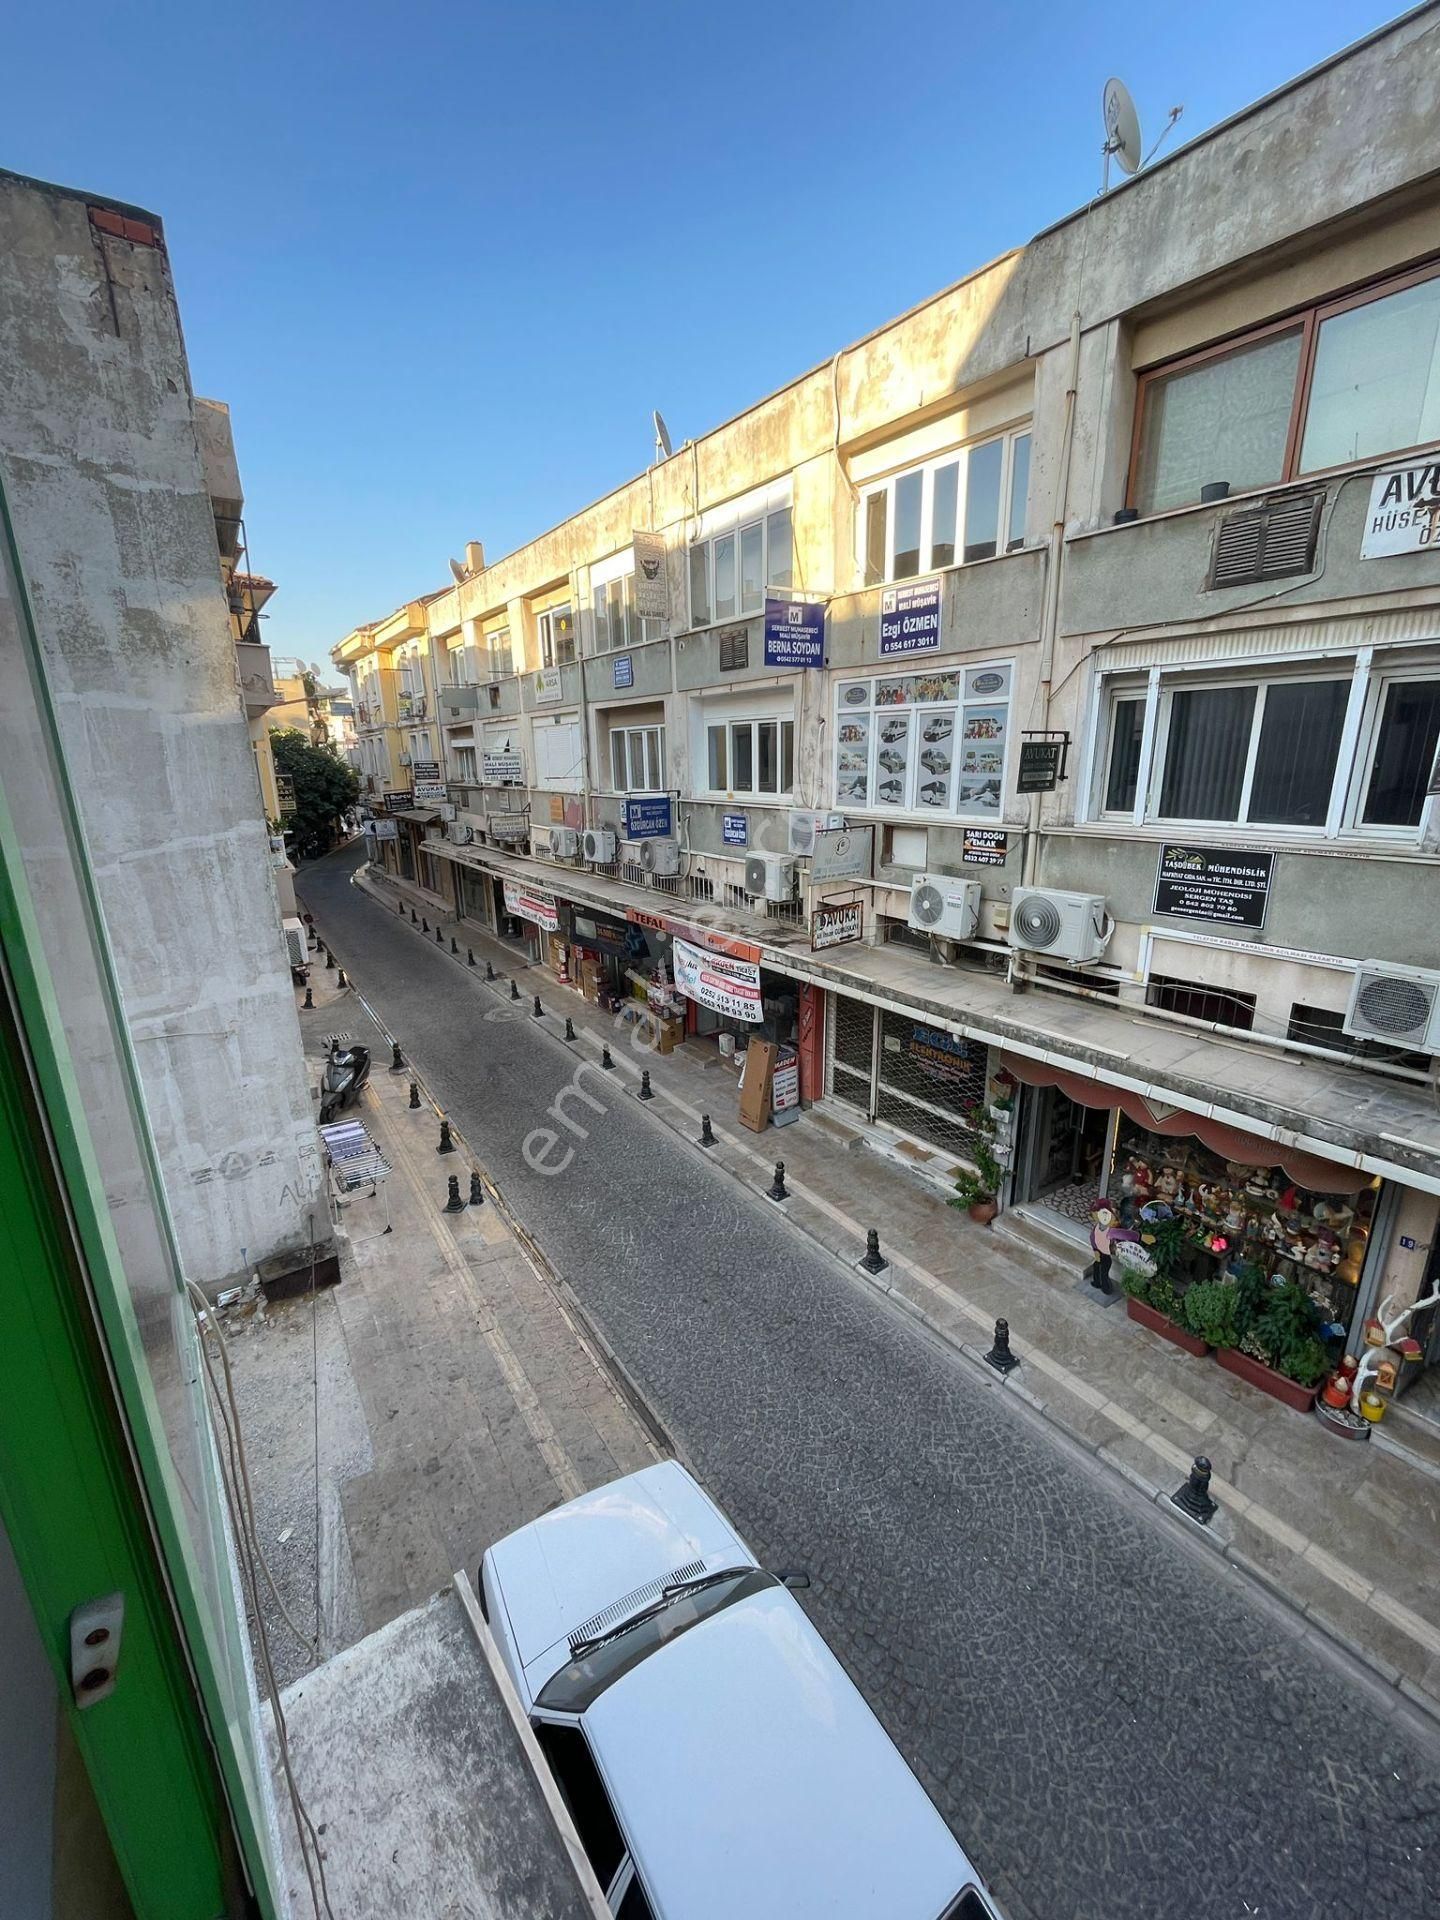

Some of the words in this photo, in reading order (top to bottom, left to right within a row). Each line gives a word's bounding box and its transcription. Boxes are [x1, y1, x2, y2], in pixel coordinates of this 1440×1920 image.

[882, 620, 901, 639] Ezgi
[902, 613, 938, 634] ÖZMEN
[768, 640, 791, 654] BERNA
[792, 641, 820, 655] SOYDAN
[884, 643, 890, 652] 0
[890, 641, 903, 651] 554
[903, 638, 916, 649] 617
[917, 635, 934, 647] 3011
[1024, 747, 1057, 760] AVUKAT
[966, 830, 982, 838] SARI
[982, 831, 1005, 841] DOĞU
[972, 839, 997, 848] EMLAK
[1207, 863, 1266, 878] MÜHENDİSLİK
[1184, 893, 1217, 903] SERGEN
[634, 912, 666, 931] TEFAL
[700, 987, 716, 999] 0252
[732, 999, 741, 1008] 11
[743, 1002, 755, 1011] 85
[744, 1011, 756, 1020] 90
[1402, 1238, 1414, 1248] 19
